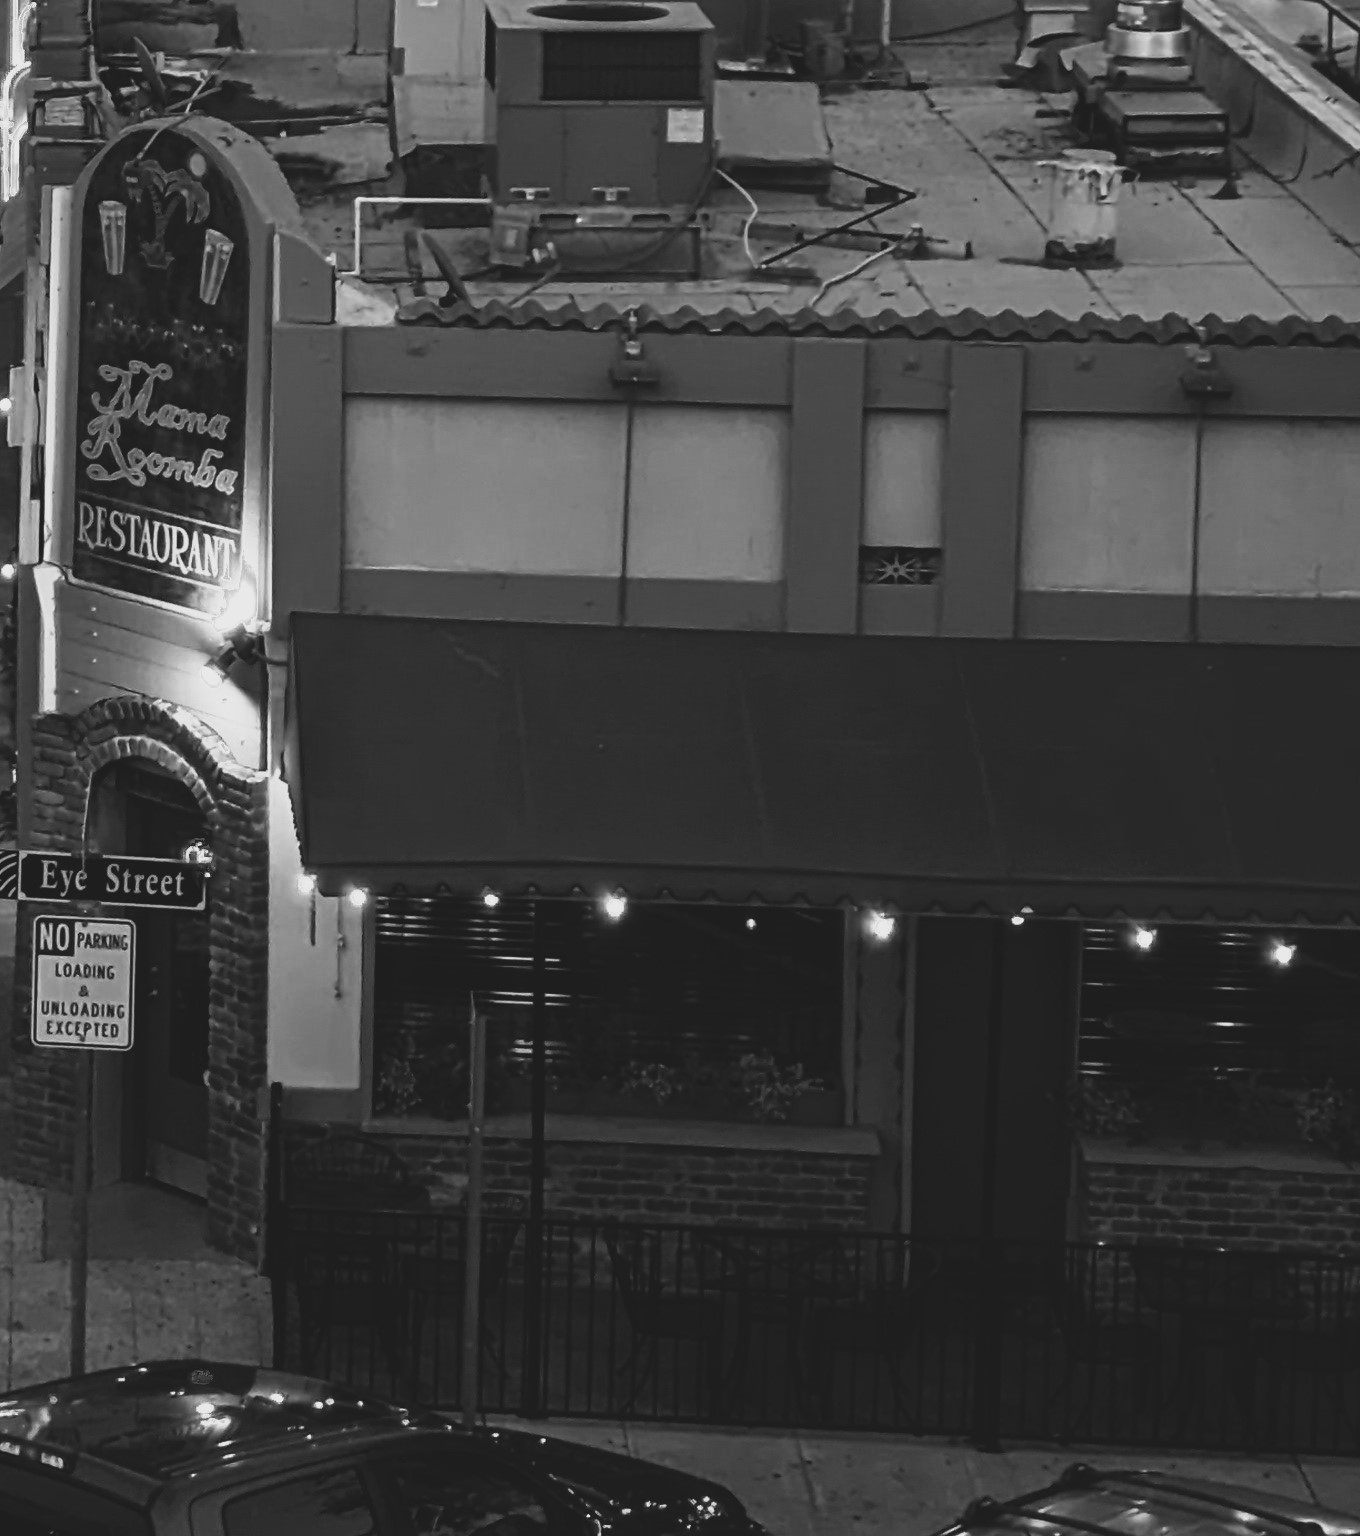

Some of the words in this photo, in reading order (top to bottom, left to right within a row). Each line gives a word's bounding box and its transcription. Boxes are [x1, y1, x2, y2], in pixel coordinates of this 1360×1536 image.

[91, 360, 231, 441] Mama
[80, 413, 240, 496] Roomba
[77, 501, 237, 582] RESTAURANT
[40, 859, 88, 897] Eye
[105, 863, 185, 897] Street
[39, 922, 70, 951] NO
[76, 931, 129, 951] PARKING
[54, 962, 116, 980] LOADING
[78, 985, 89, 998] &
[40, 999, 126, 1019] UNLOADING
[46, 1019, 120, 1039] EXCEPTED
